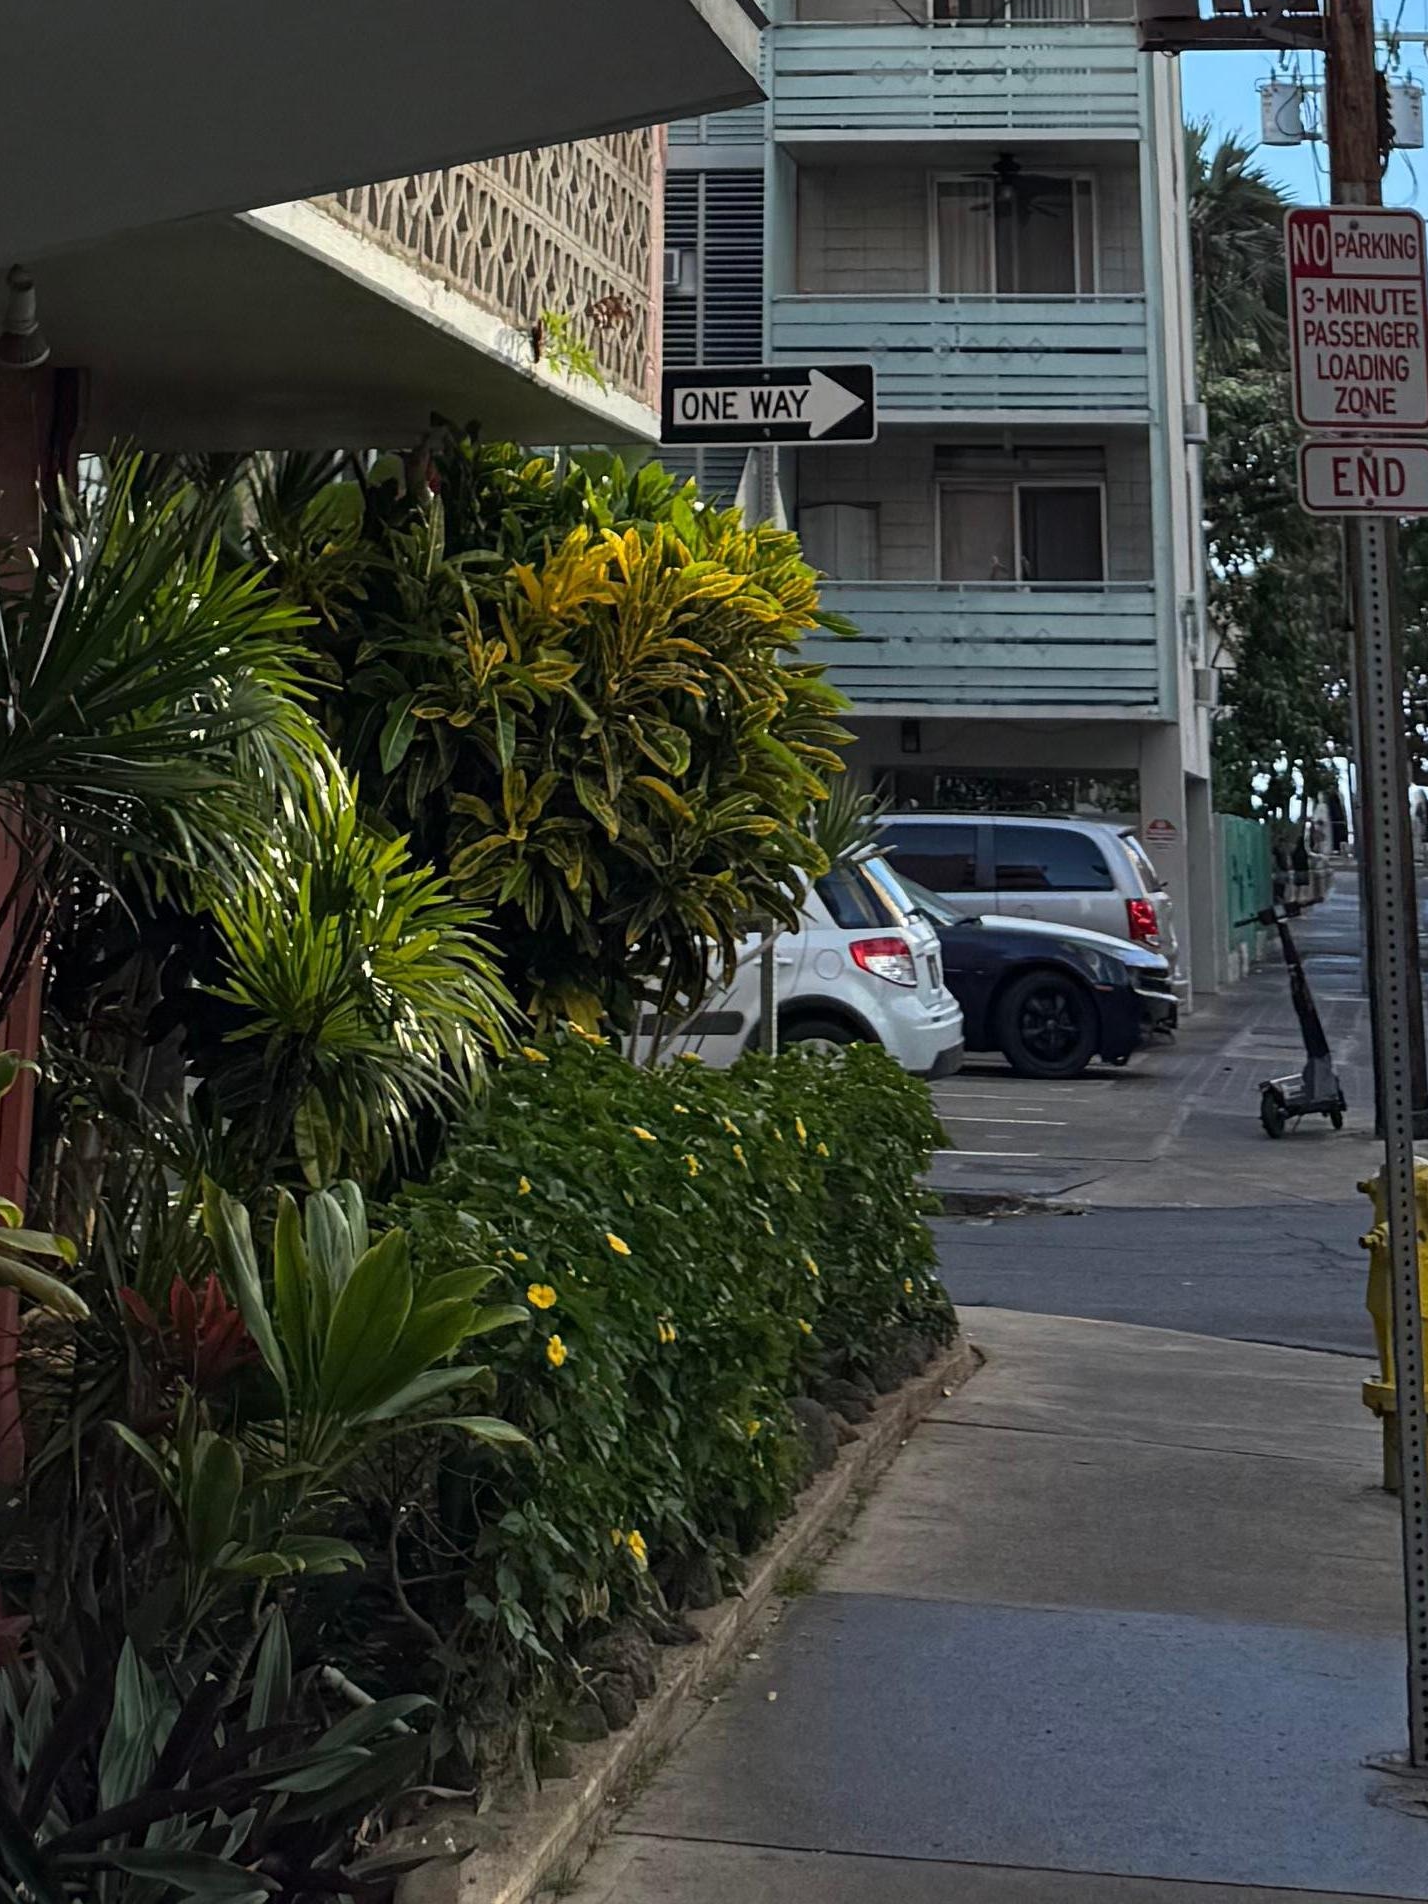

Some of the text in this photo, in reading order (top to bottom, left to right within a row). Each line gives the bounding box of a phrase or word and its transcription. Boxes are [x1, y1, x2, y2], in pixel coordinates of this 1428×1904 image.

[1292, 224, 1417, 267] NO PARKING
[1302, 289, 1418, 315] 3-MINUTE
[1305, 322, 1420, 348] PASSENGER
[1318, 356, 1410, 381] LOADING
[682, 390, 809, 420] ONE WAY
[1335, 388, 1397, 415] ZONE
[1334, 457, 1405, 497] END
